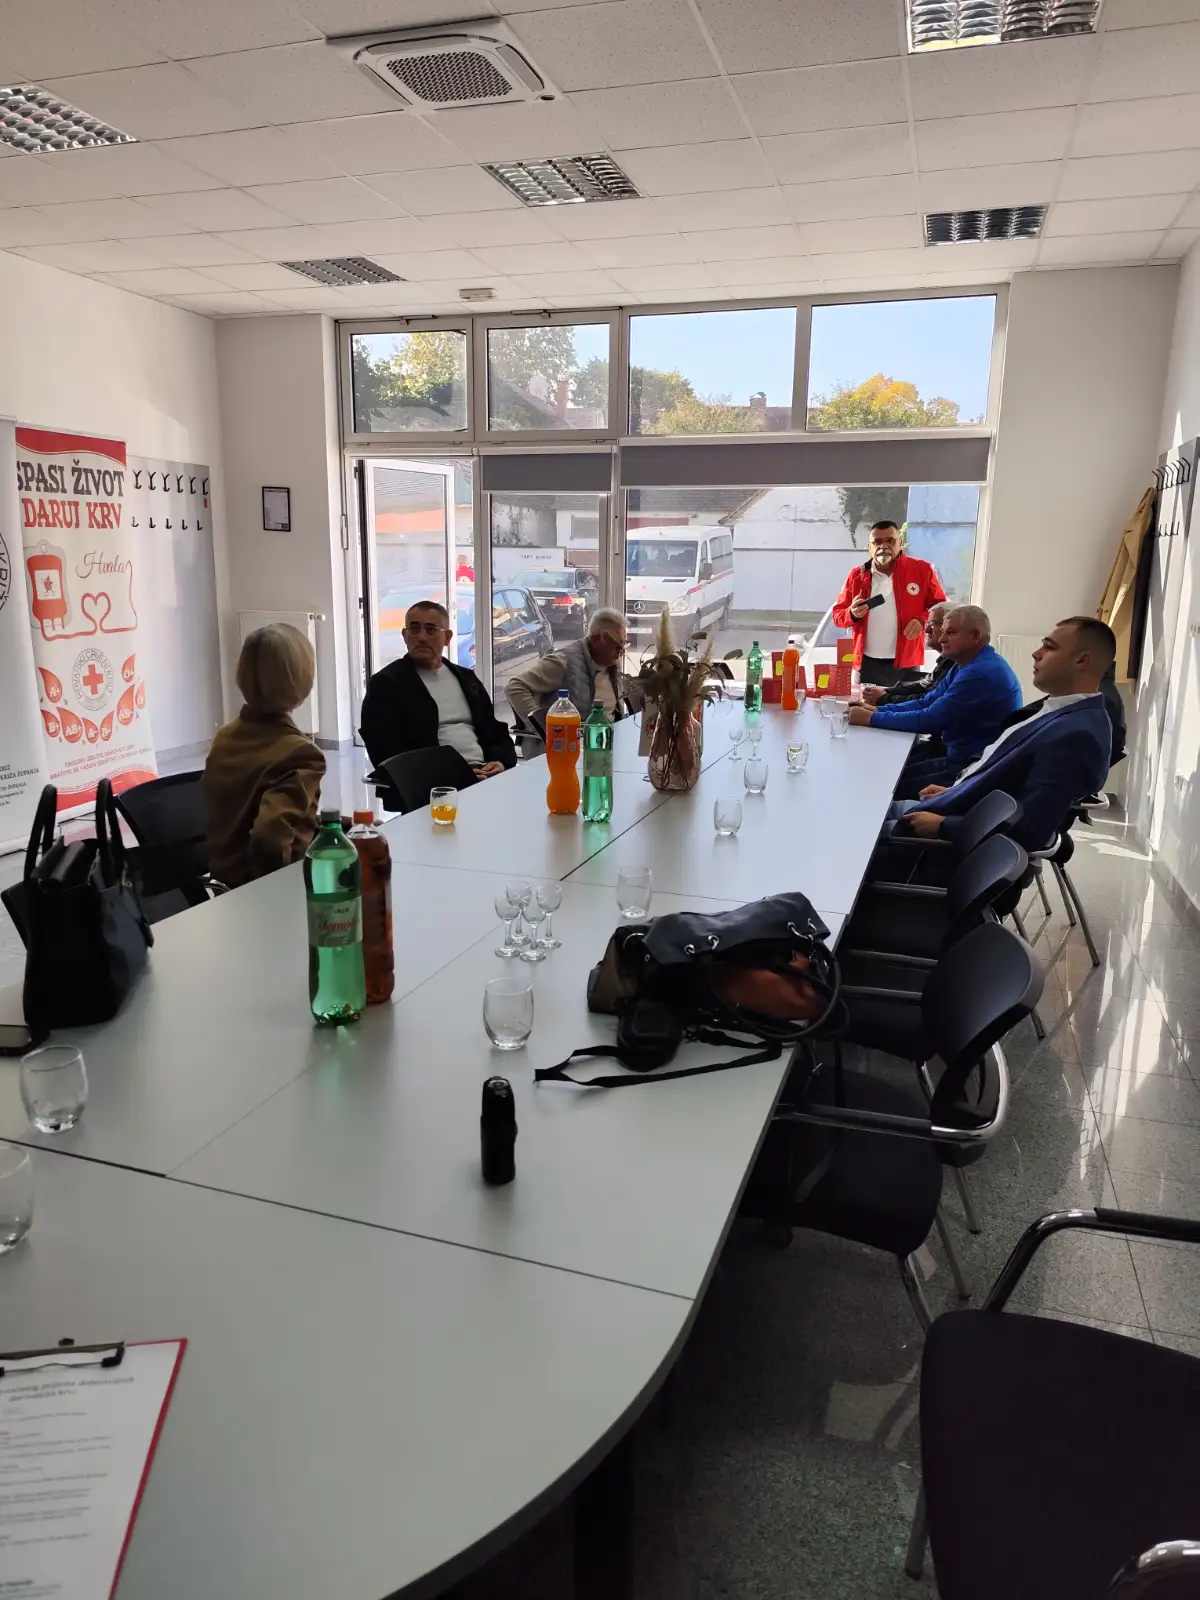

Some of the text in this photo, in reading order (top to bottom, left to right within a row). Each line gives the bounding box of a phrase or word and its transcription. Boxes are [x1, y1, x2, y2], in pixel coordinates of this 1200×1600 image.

[71, 458, 124, 497] ŽIVOT
[21, 498, 122, 529] DARUJ KRV
[75, 550, 126, 579] Hvala
[49, 686, 60, 698] A+
[48, 721, 60, 733] B+
[65, 724, 81, 736] AB+
